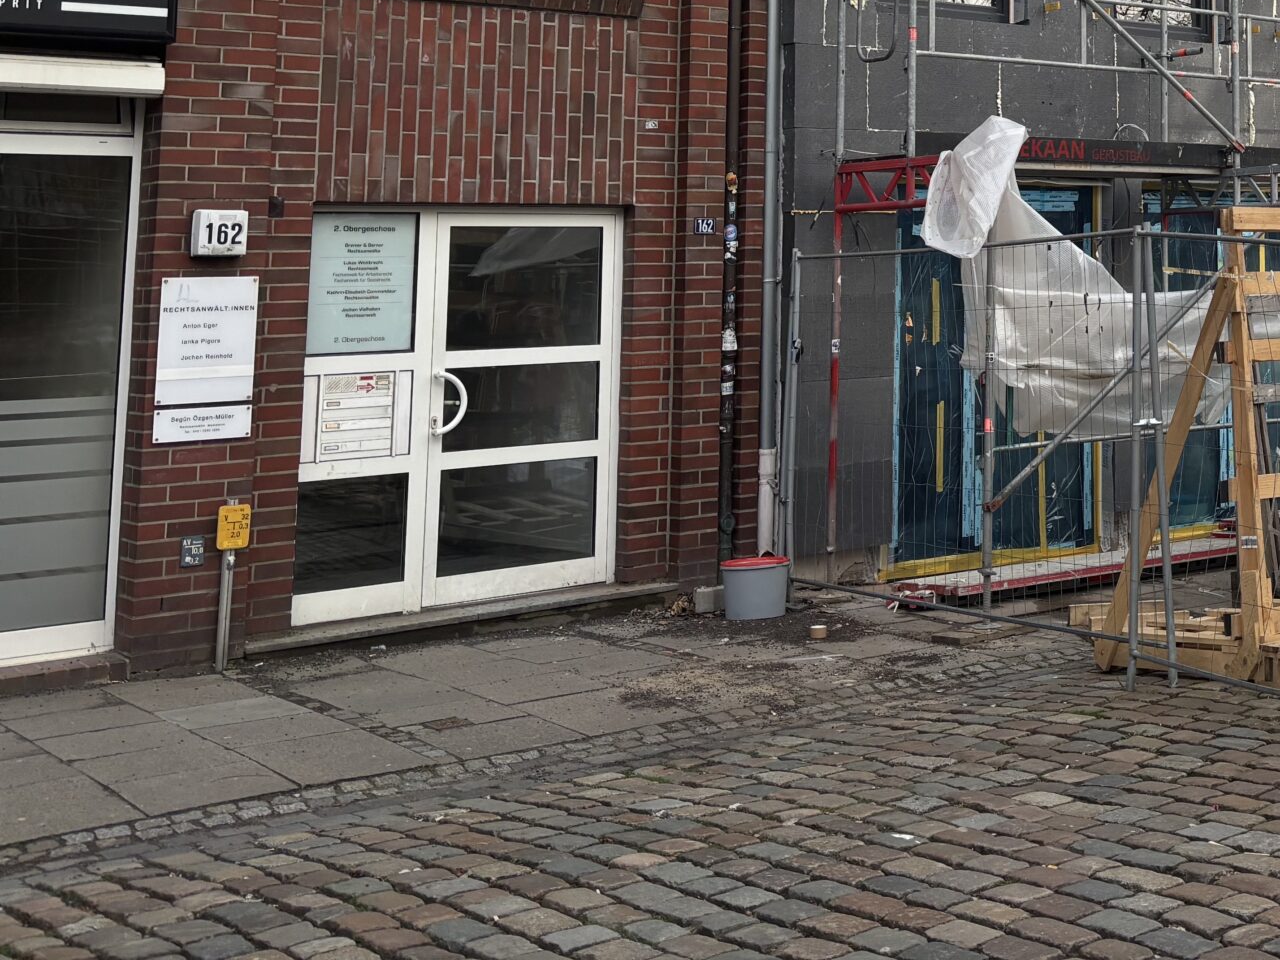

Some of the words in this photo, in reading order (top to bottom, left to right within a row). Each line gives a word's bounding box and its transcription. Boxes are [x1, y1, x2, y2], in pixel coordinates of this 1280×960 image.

[1020, 139, 1086, 160] EKAAN
[343, 225, 396, 234] Obergeschoss
[698, 220, 714, 233] 162
[206, 222, 243, 245] 162
[241, 513, 250, 521] 32
